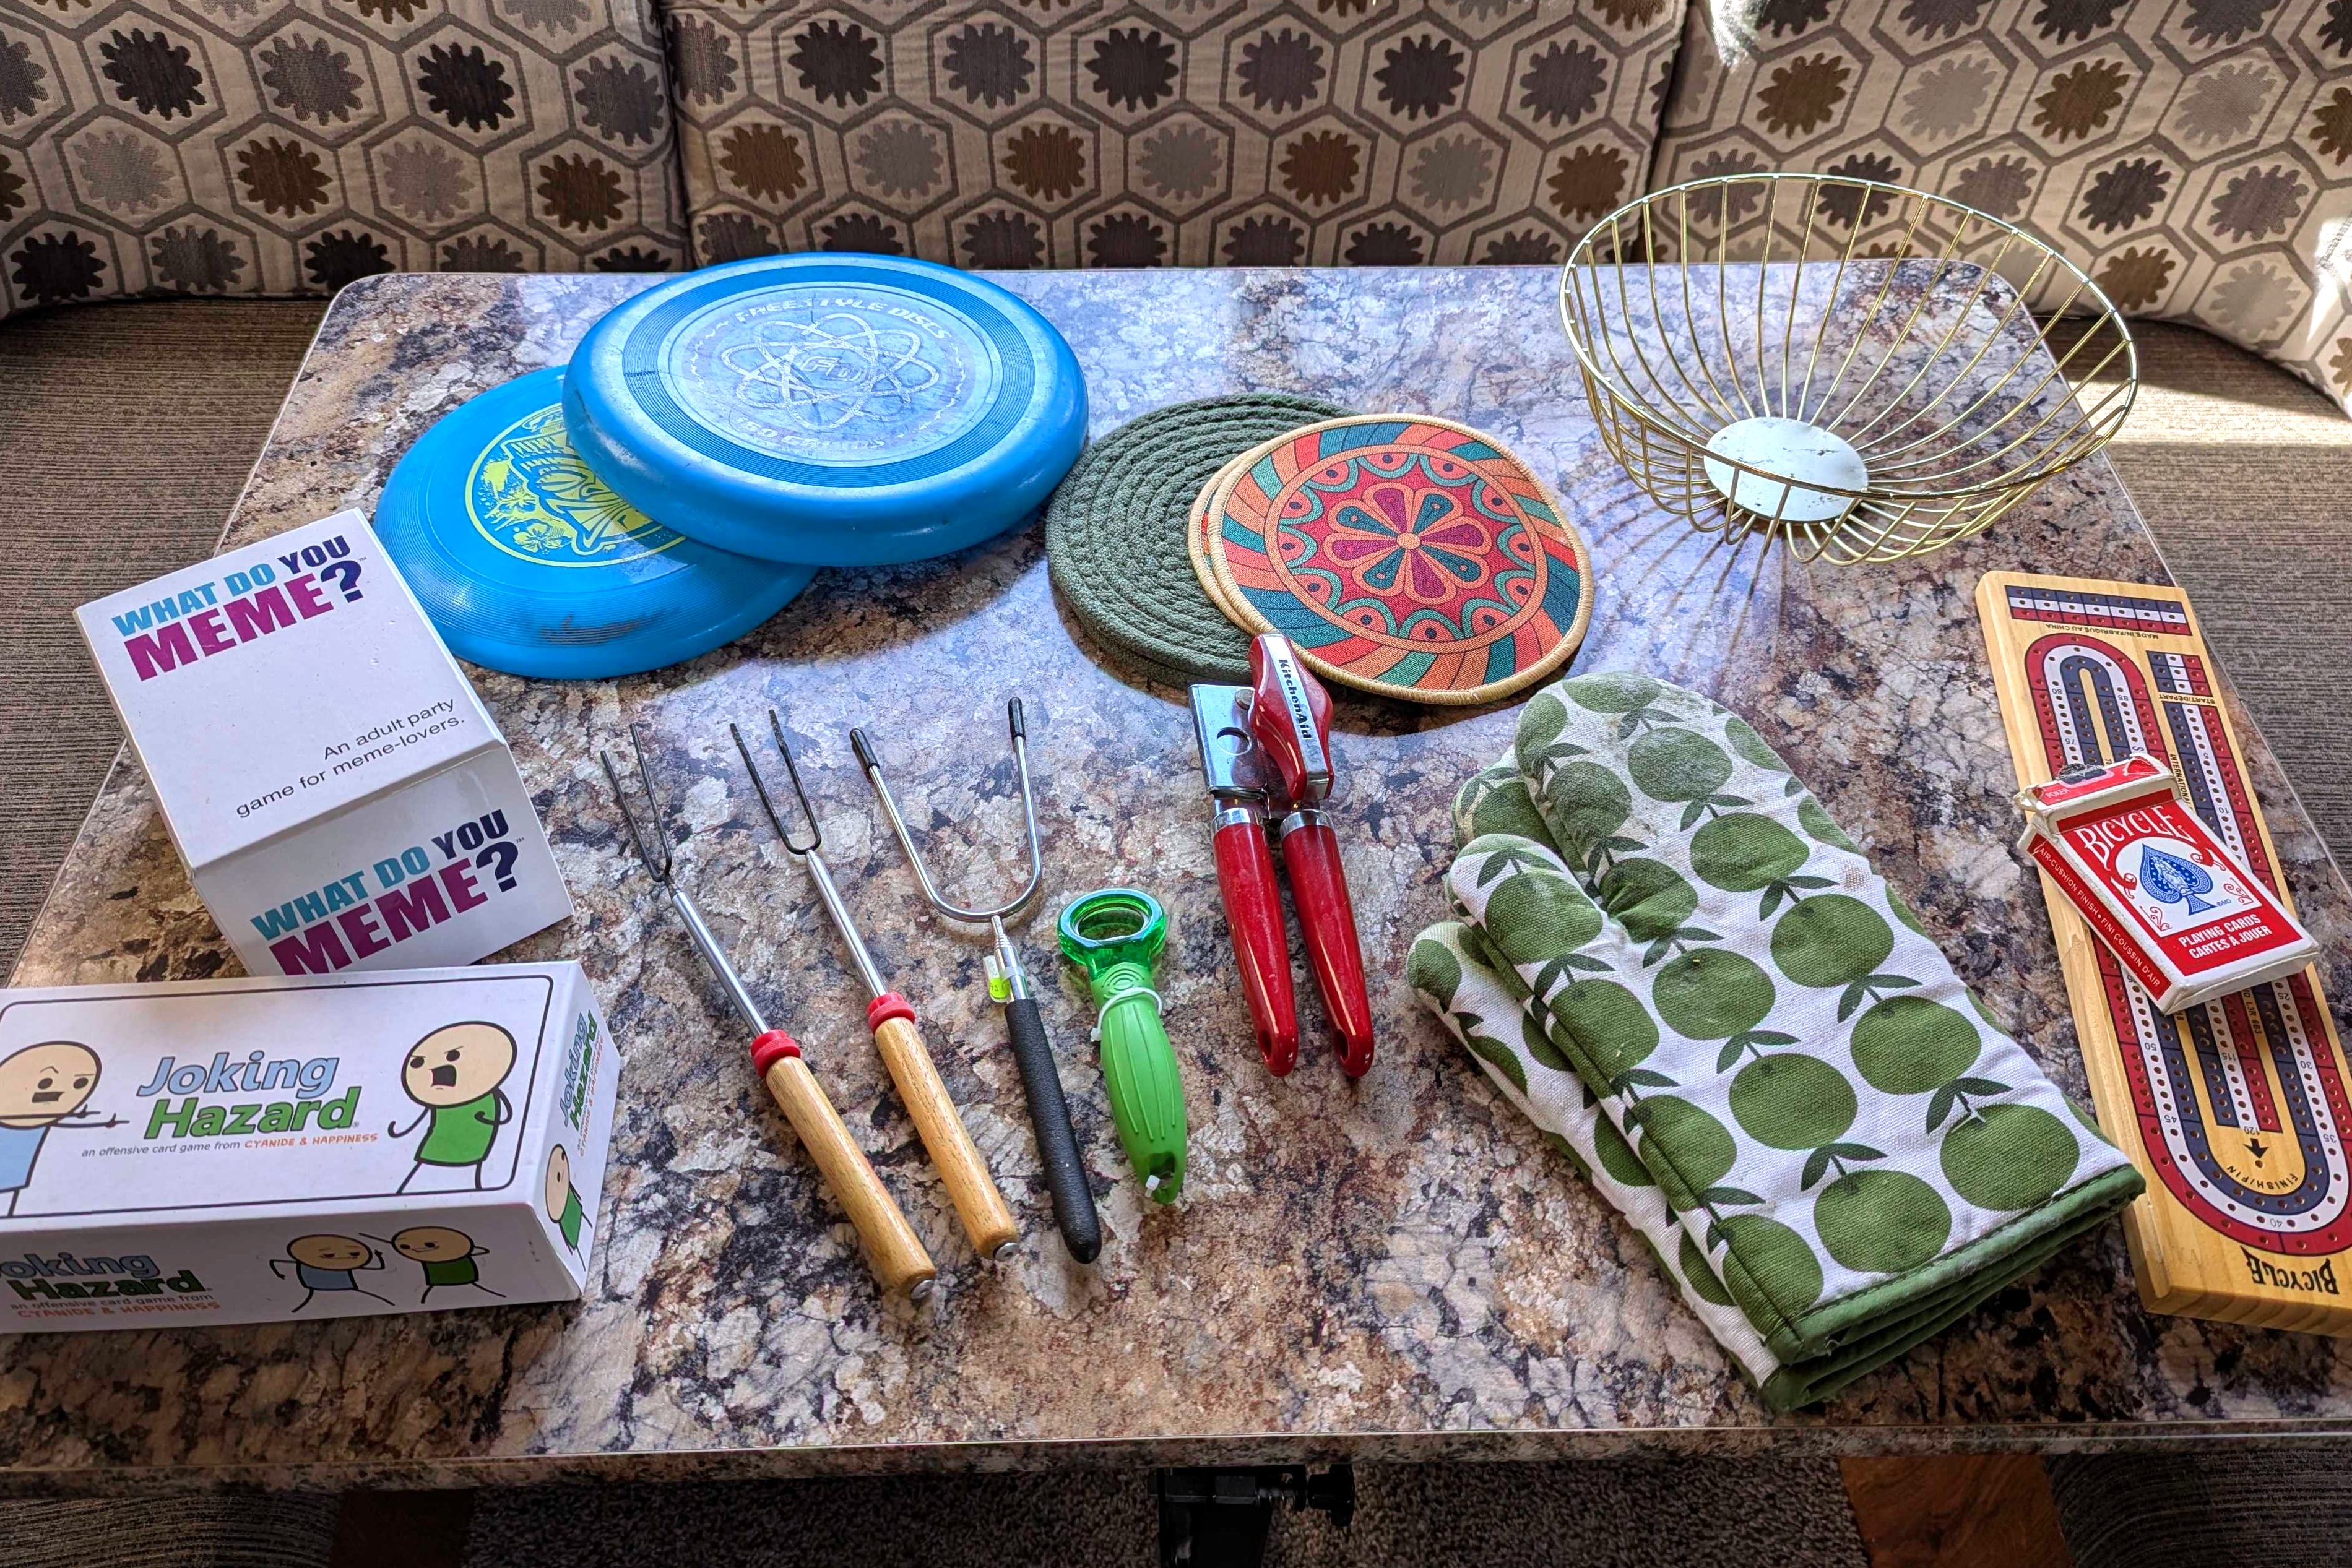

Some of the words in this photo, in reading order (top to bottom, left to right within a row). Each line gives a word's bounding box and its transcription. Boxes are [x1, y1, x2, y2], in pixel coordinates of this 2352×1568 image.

[111, 581, 218, 637] WHAT
[223, 562, 277, 597] DO
[277, 535, 351, 575] YOU
[124, 559, 364, 682] MEME?
[1278, 658, 1313, 740] KitchenAid
[324, 742, 351, 760] An
[355, 718, 405, 746] adult
[407, 699, 454, 726] party
[236, 785, 295, 819] game
[298, 770, 327, 789] for
[332, 715, 465, 776] meme-lovers.
[2045, 788, 2072, 799] POKER
[2073, 804, 2197, 871] BICYCLE
[249, 871, 370, 941] WHAT
[373, 846, 430, 889] DO
[431, 809, 509, 861] YOU
[268, 840, 519, 976] MEME?
[2039, 847, 2078, 893] AIR-CUSHION
[2077, 889, 2099, 917] FINISH
[2100, 916, 2115, 935] FINI
[2113, 933, 2143, 968] COUSSIN
[2141, 965, 2161, 988] D'AIR
[2177, 925, 2226, 948] PLAYING
[2223, 913, 2262, 933] CARDS
[2188, 938, 2231, 960] CARTES
[2226, 933, 2241, 947] À
[2238, 924, 2273, 944] JOUER
[2277, 991, 2291, 1001] 25
[2144, 1042, 2158, 1051] 50
[136, 1049, 340, 1100] Joking
[559, 1012, 587, 1128] Joking
[569, 1009, 597, 1132] Hazard
[2299, 1060, 2313, 1070] 30
[144, 1085, 363, 1140] Hazard
[2163, 1114, 2177, 1124] 45
[2243, 1125, 2260, 1136] 120
[81, 1148, 95, 1157] an
[98, 1144, 150, 1157] offensive
[151, 1143, 177, 1153] card
[178, 1143, 211, 1155] game
[214, 1139, 241, 1151] from
[244, 1137, 295, 1150] CYANIDE
[299, 1137, 308, 1145] &
[311, 1132, 378, 1145] HAPPINESS
[2322, 1133, 2337, 1144] 35
[2270, 1218, 2283, 1228] 40
[0, 1251, 160, 1278] oking
[2239, 1244, 2340, 1295] BICYCLE
[6, 1269, 207, 1301] Hazard
[32, 1299, 97, 1310] offensive
[100, 1297, 130, 1306] card
[136, 1295, 176, 1305] game
[178, 1293, 214, 1302] from
[17, 1307, 96, 1319] CYANIDE
[121, 1302, 221, 1314] HAPPINESS
